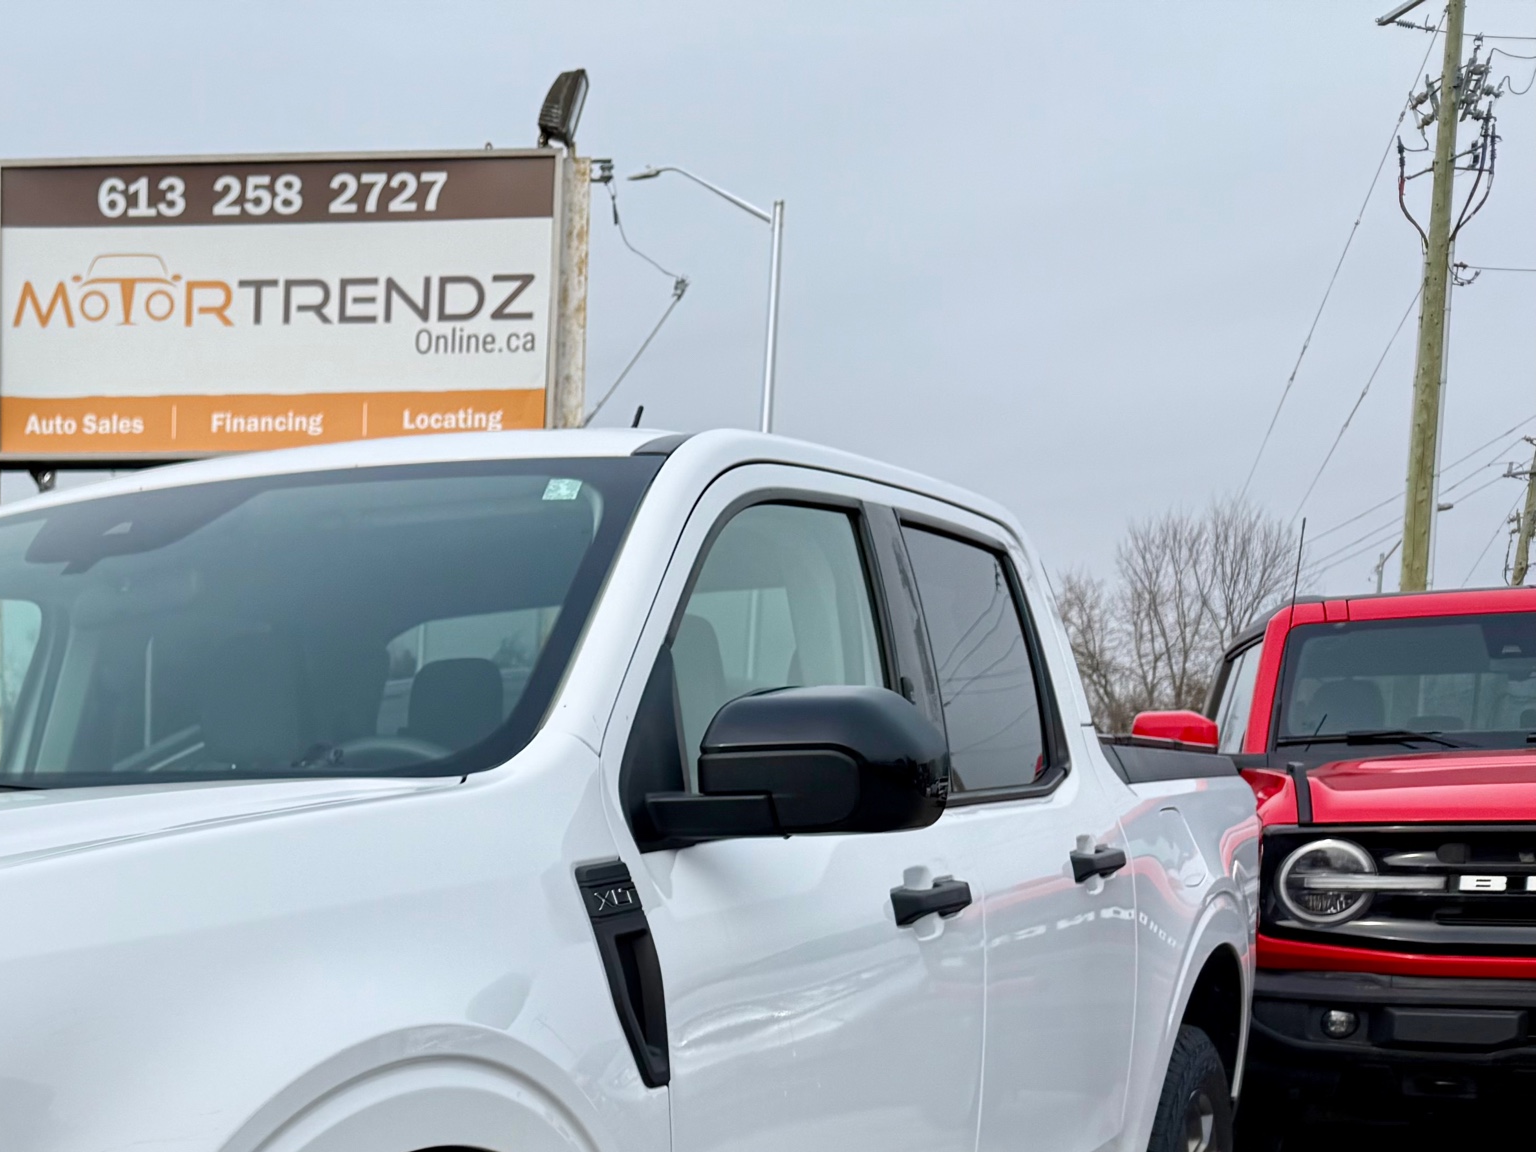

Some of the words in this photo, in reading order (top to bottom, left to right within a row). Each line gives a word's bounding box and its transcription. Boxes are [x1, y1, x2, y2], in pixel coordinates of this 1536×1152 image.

[96, 176, 187, 219] 613
[212, 173, 304, 217] 258
[328, 170, 449, 214] 2727
[414, 325, 536, 356] Online.ca
[24, 411, 78, 436] Auto
[81, 411, 145, 436] Sales
[210, 410, 324, 440] Financing
[401, 406, 504, 434] Locating
